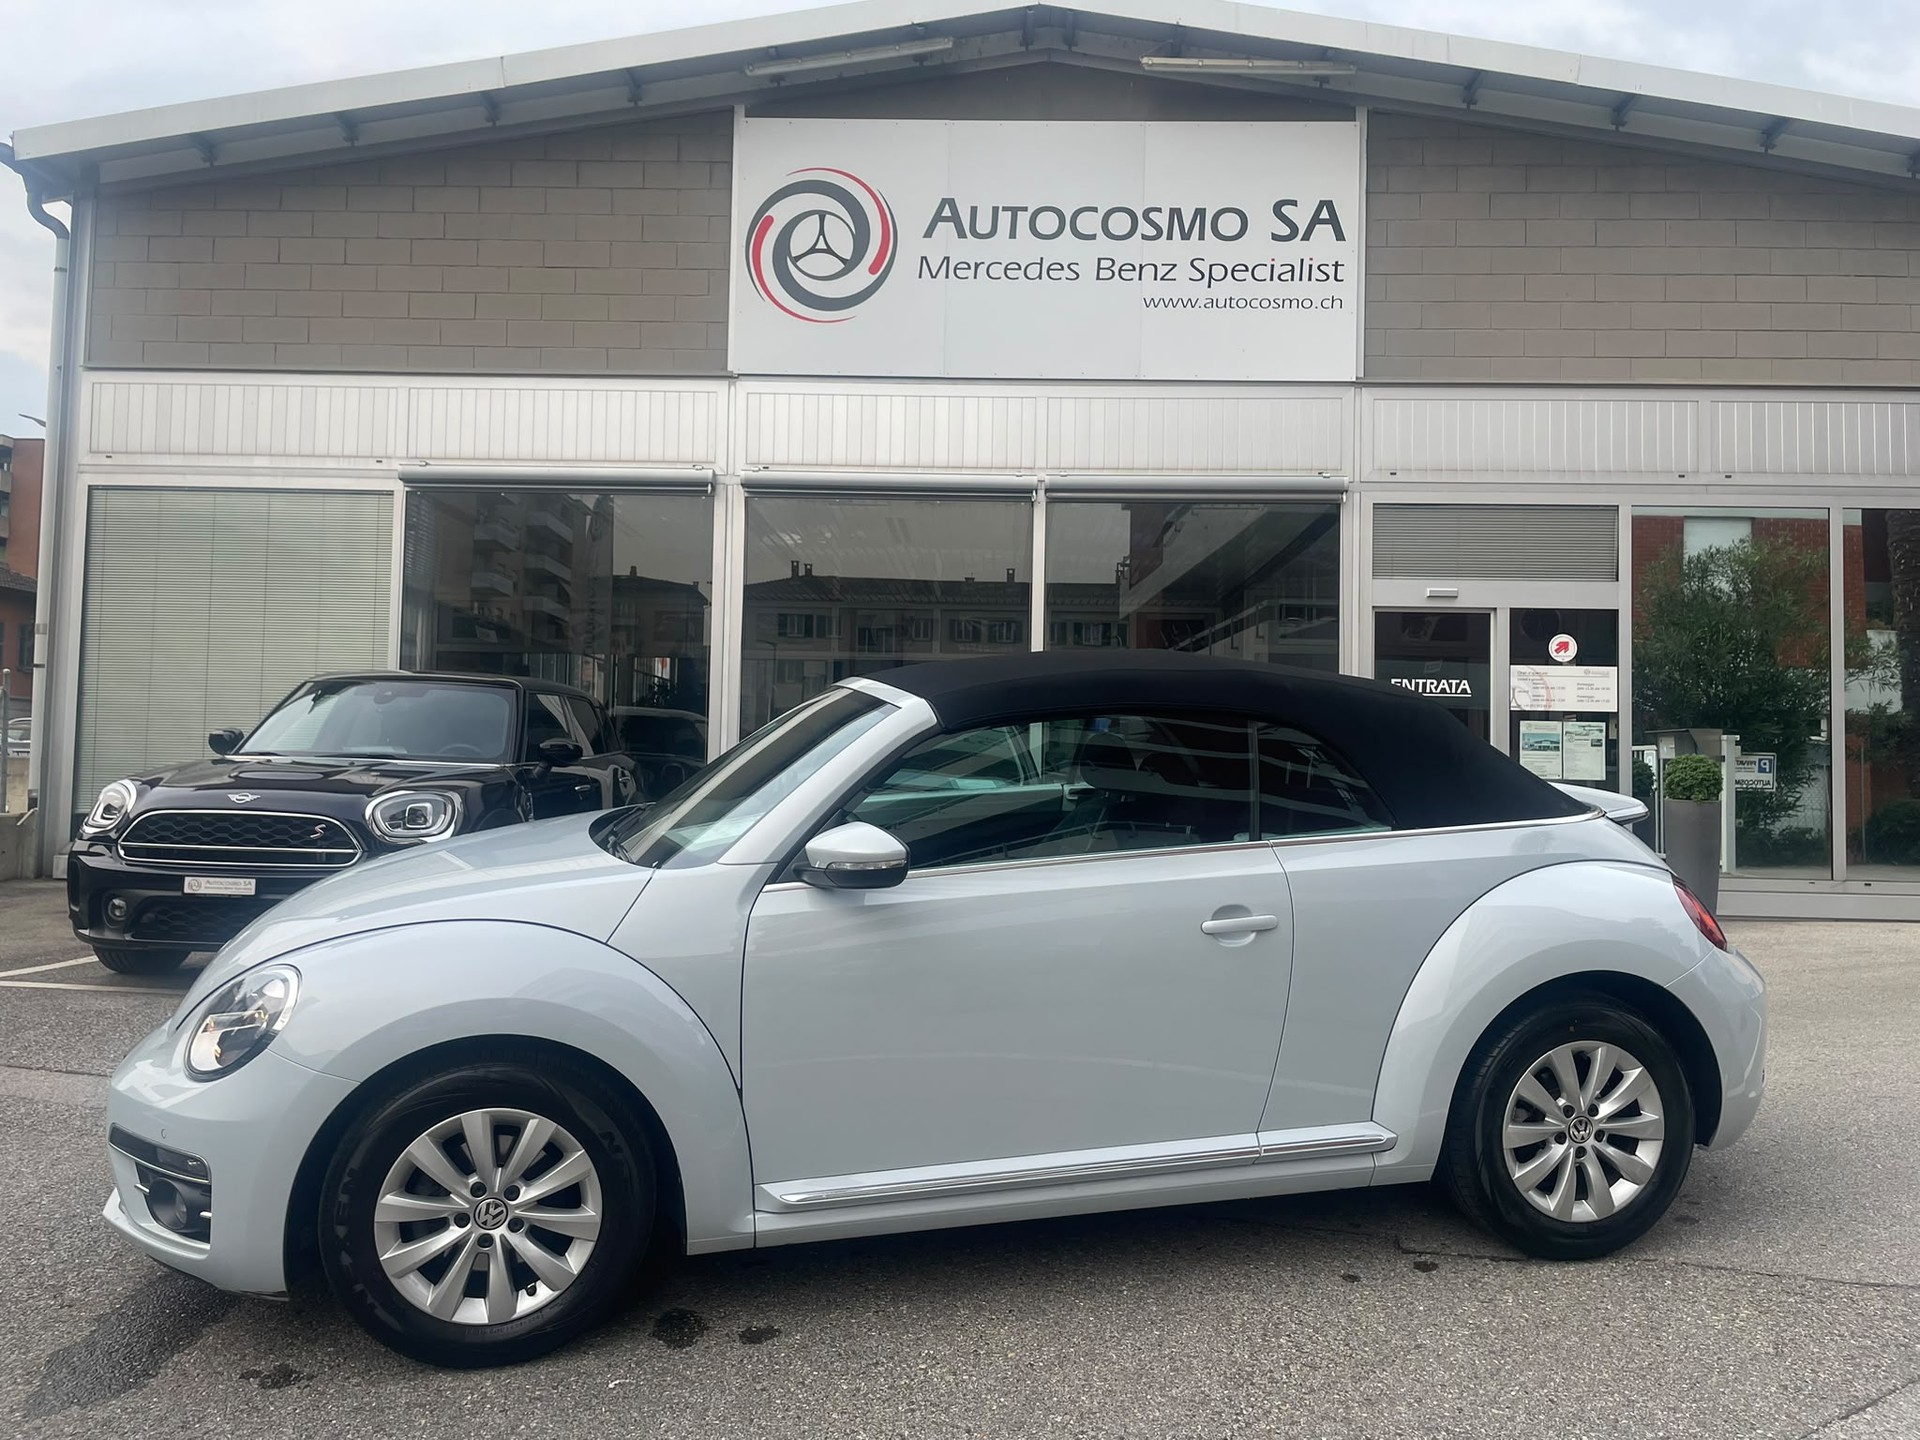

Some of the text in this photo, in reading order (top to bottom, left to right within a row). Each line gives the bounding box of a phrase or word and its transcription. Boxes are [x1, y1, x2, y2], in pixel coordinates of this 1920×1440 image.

[922, 197, 1347, 242] AUTOCOSMO SA
[918, 255, 1345, 288] Mercedes Benz Specialist
[1142, 295, 1344, 310] www.autocosmo.ch
